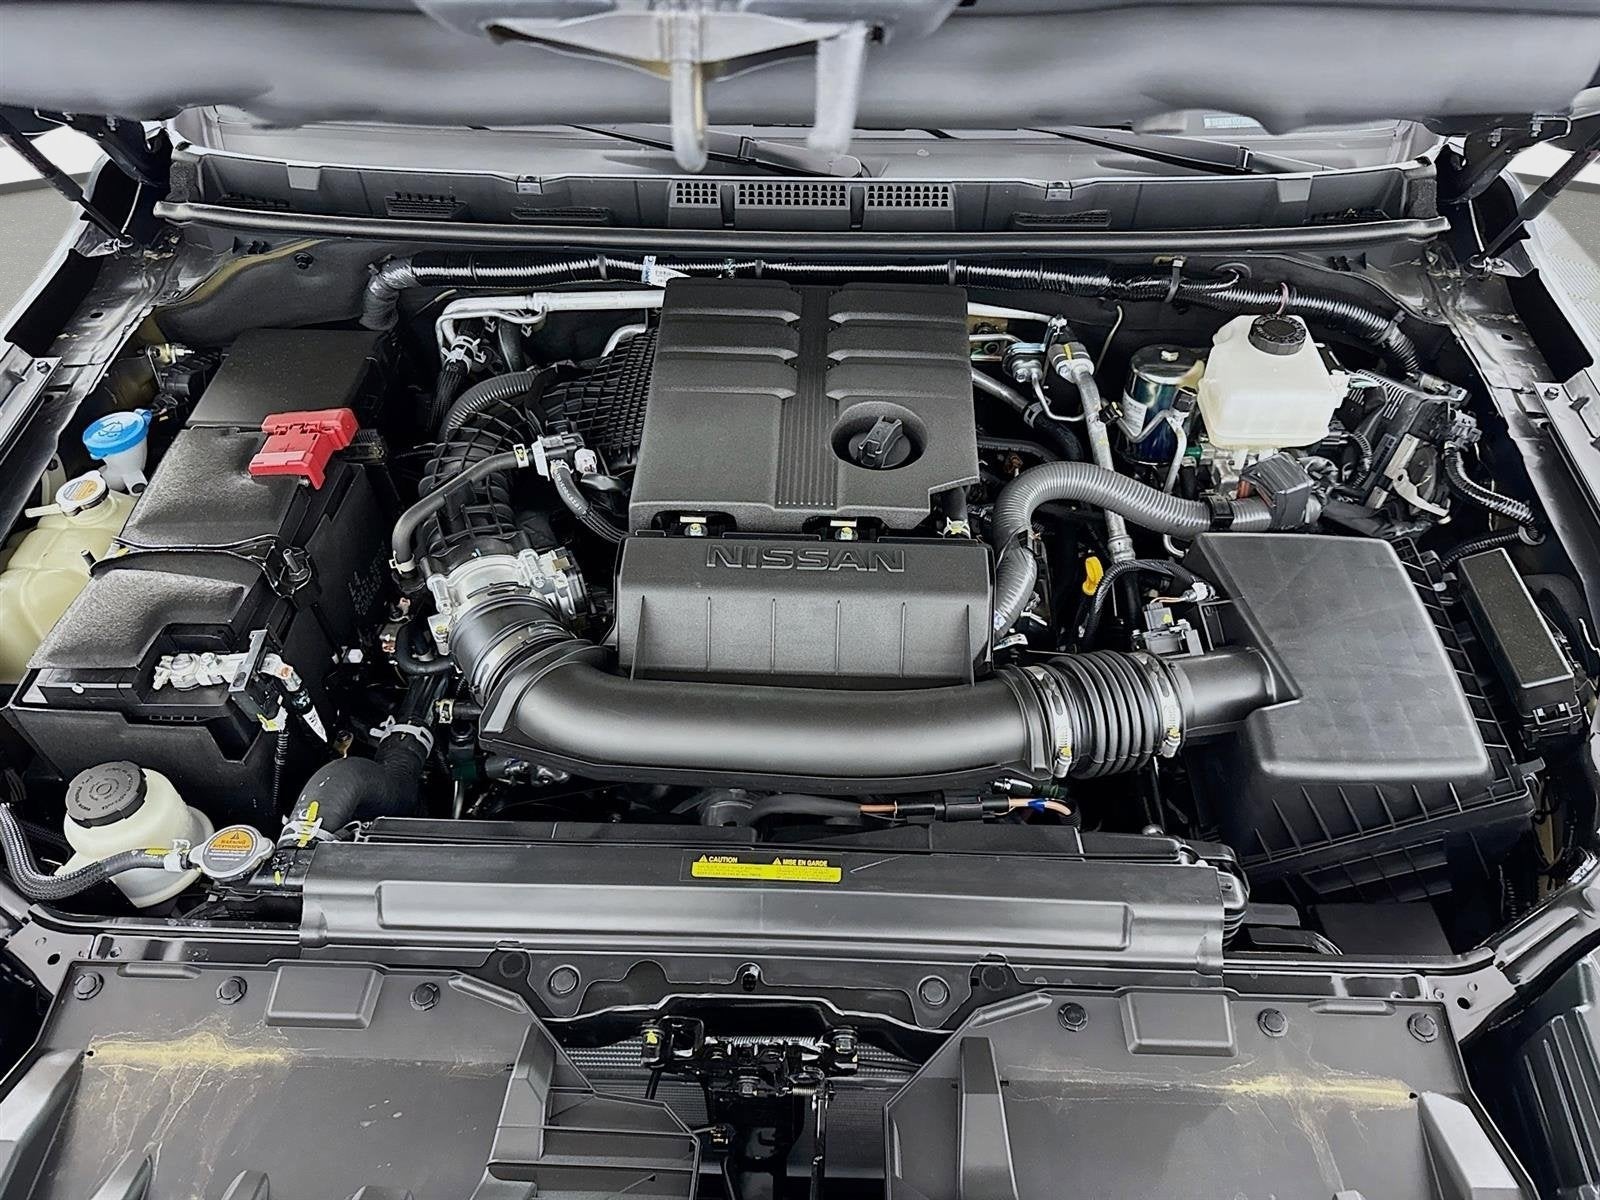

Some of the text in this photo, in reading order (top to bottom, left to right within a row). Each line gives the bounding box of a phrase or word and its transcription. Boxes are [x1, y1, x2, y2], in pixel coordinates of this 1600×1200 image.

[705, 543, 906, 573] NISSAN
[708, 856, 738, 864] CAUTION
[782, 858, 797, 866] MISE
